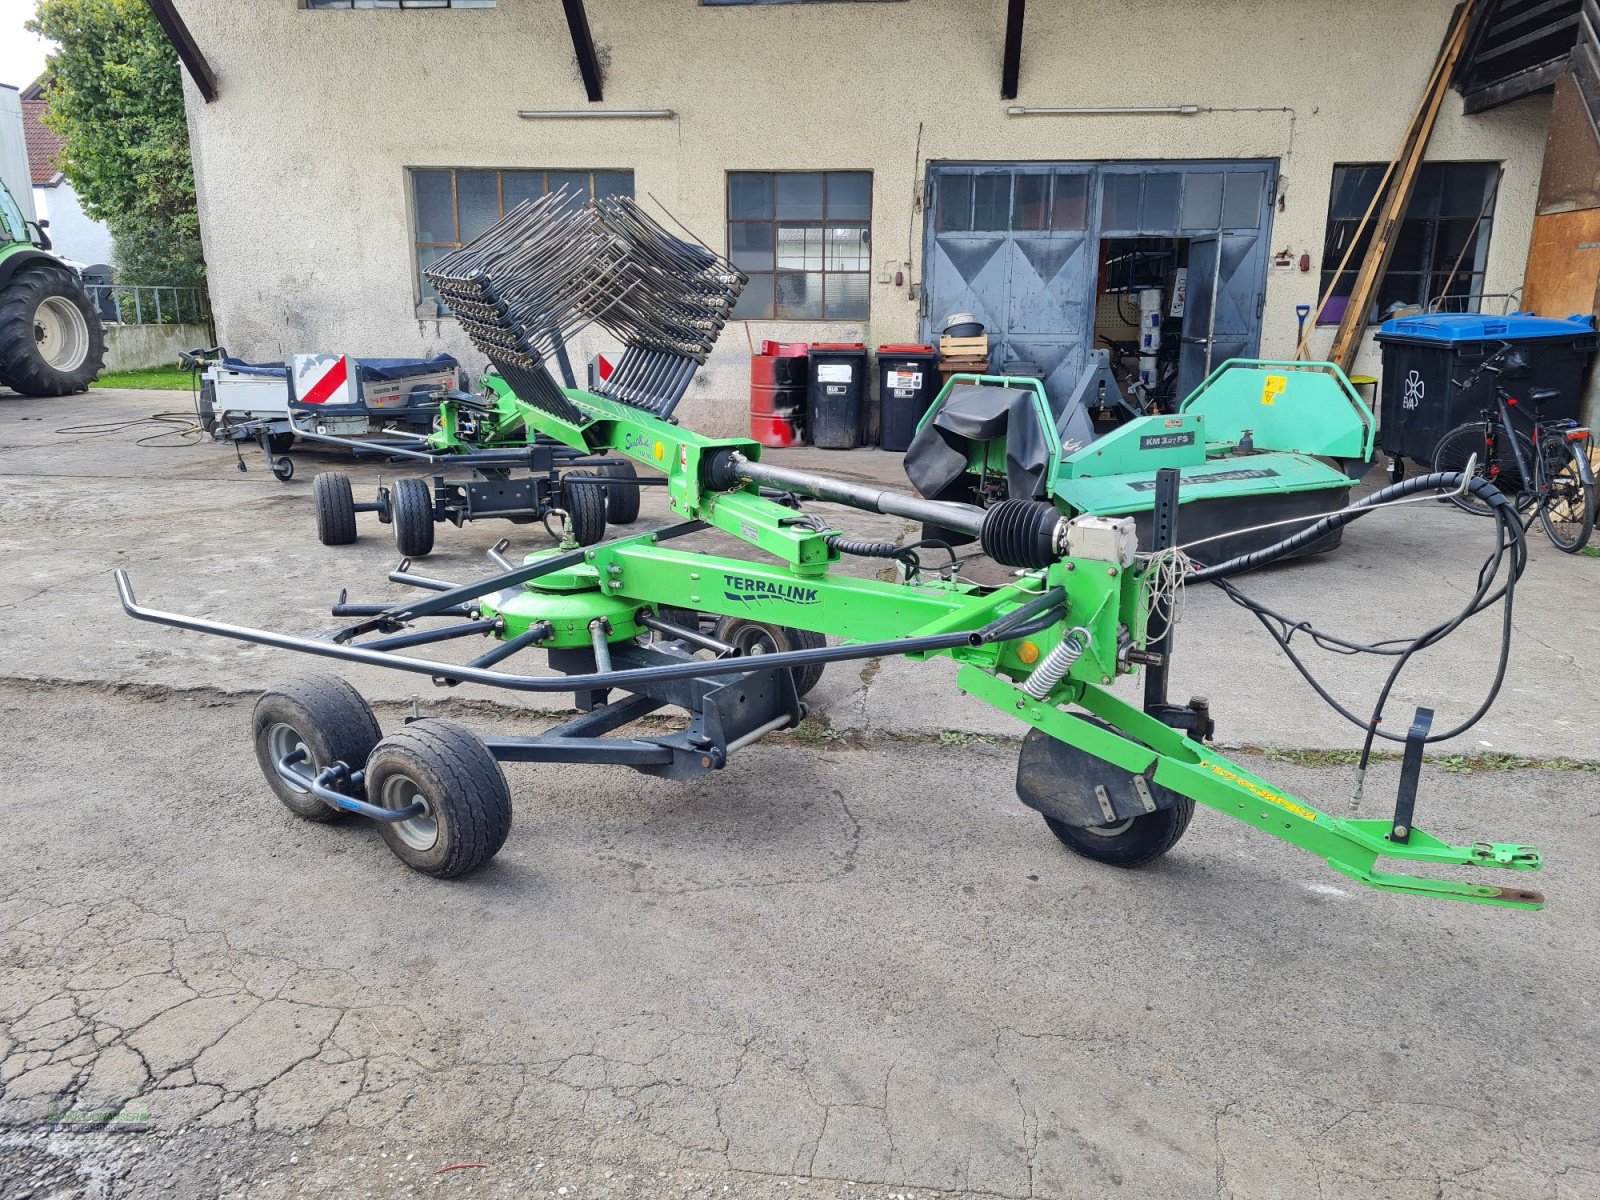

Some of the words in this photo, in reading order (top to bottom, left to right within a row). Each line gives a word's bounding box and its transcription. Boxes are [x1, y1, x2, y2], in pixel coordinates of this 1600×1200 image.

[1146, 437, 1160, 446] KM
[1177, 435, 1189, 443] FS
[724, 575, 818, 601] TERRALINK
